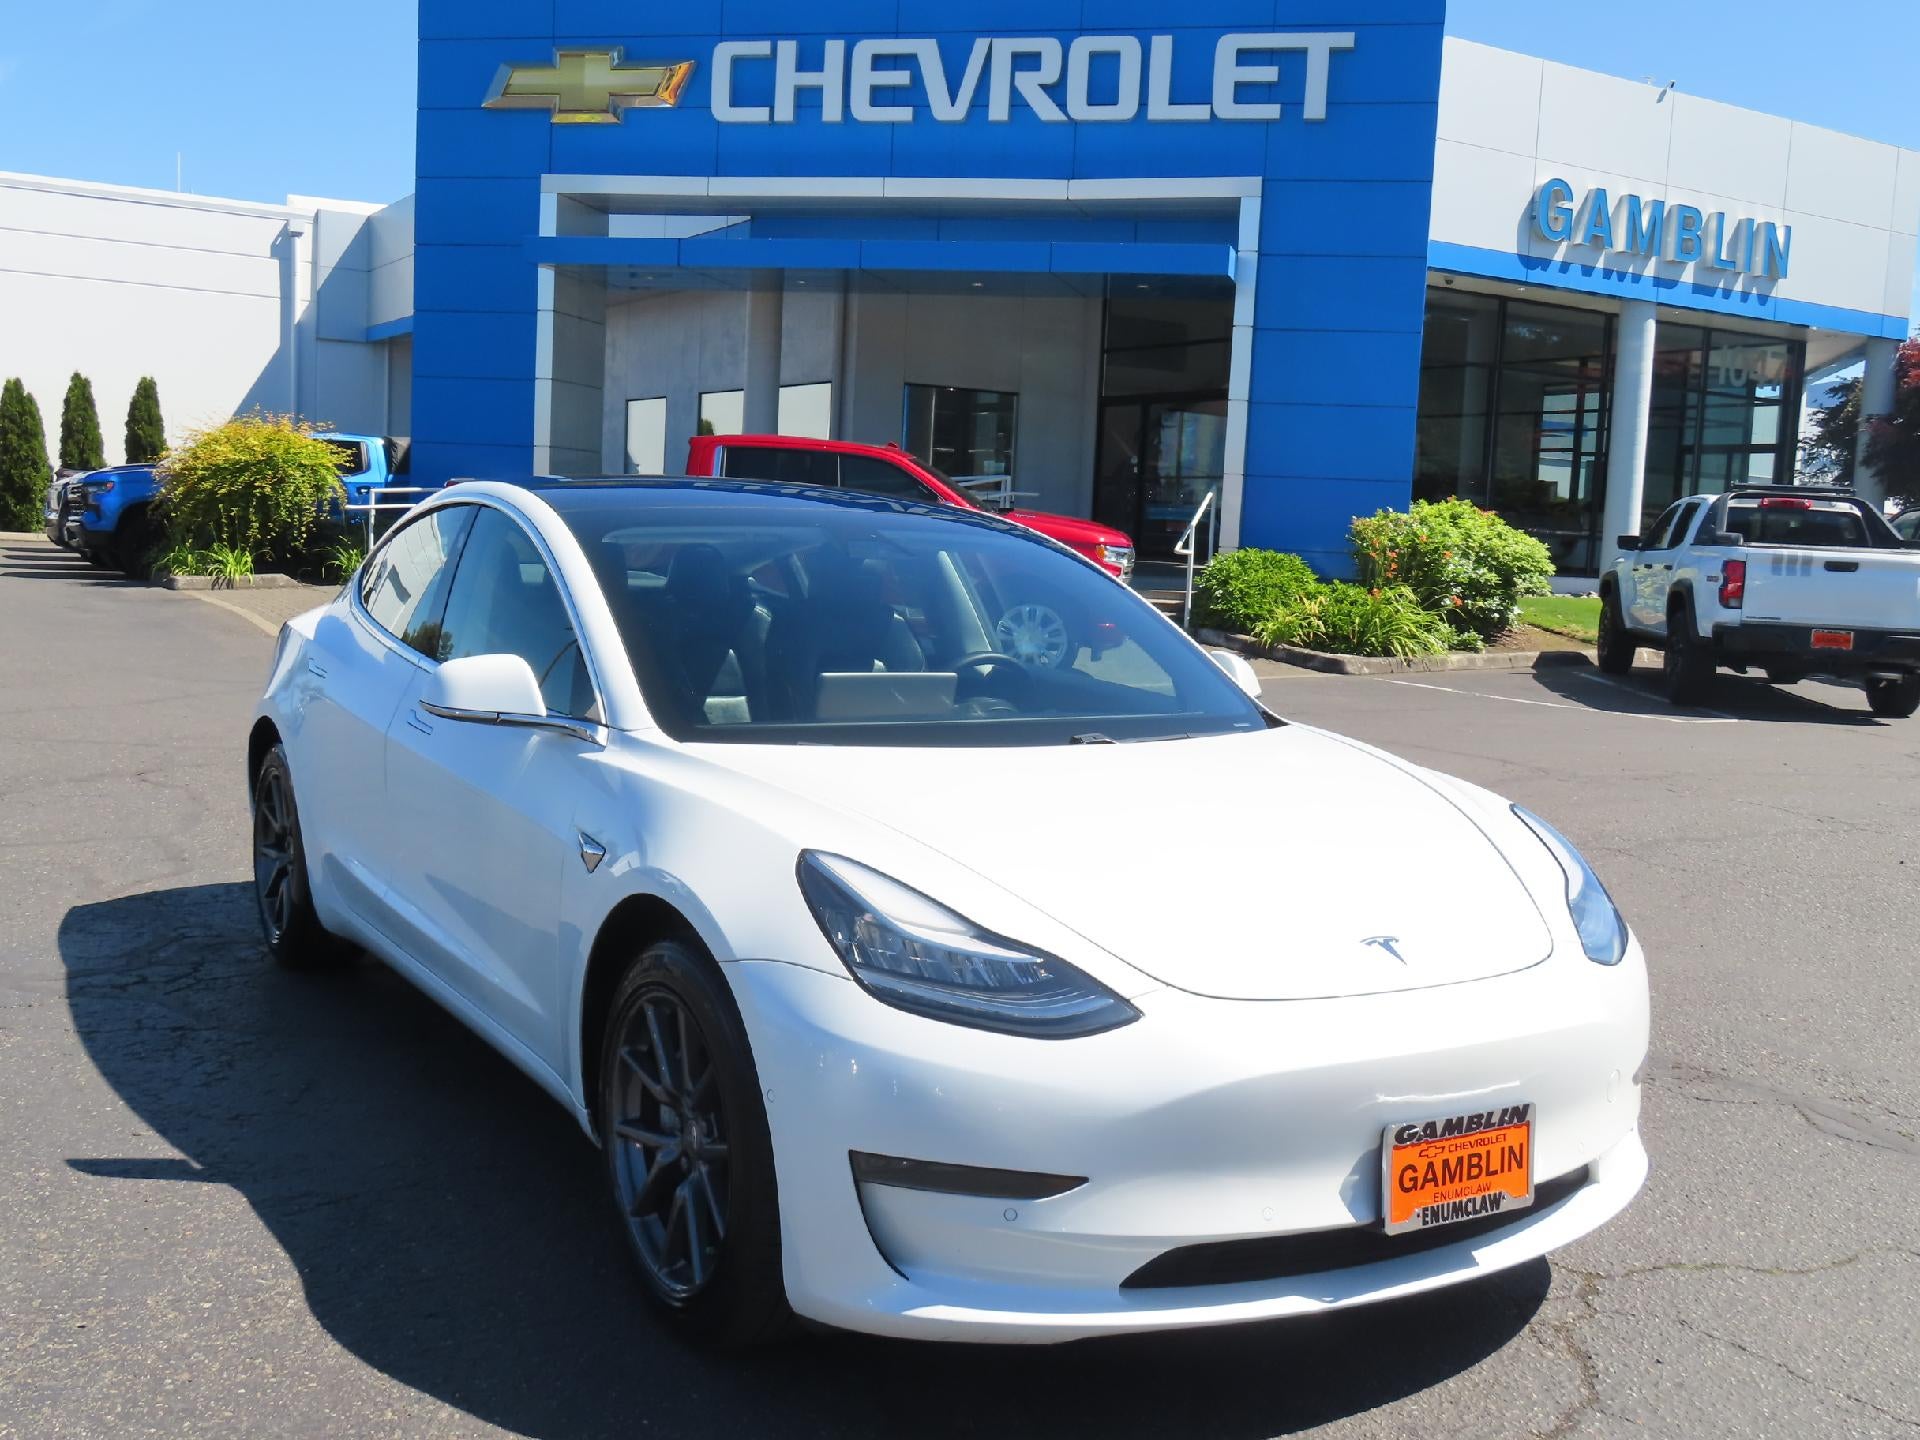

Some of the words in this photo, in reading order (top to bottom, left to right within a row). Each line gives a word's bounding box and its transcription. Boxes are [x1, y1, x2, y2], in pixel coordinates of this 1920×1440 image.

[710, 32, 1356, 123] CHEVROLET
[1537, 177, 1792, 279] GAMBLIN
[1394, 1103, 1530, 1144] GAMBLIN
[1448, 1133, 1507, 1153] CHEVROLET
[1398, 1142, 1524, 1193] GAMBLIN
[1422, 1191, 1503, 1226] ENUMCLAW
[1433, 1182, 1492, 1203] ENUMCLAW
